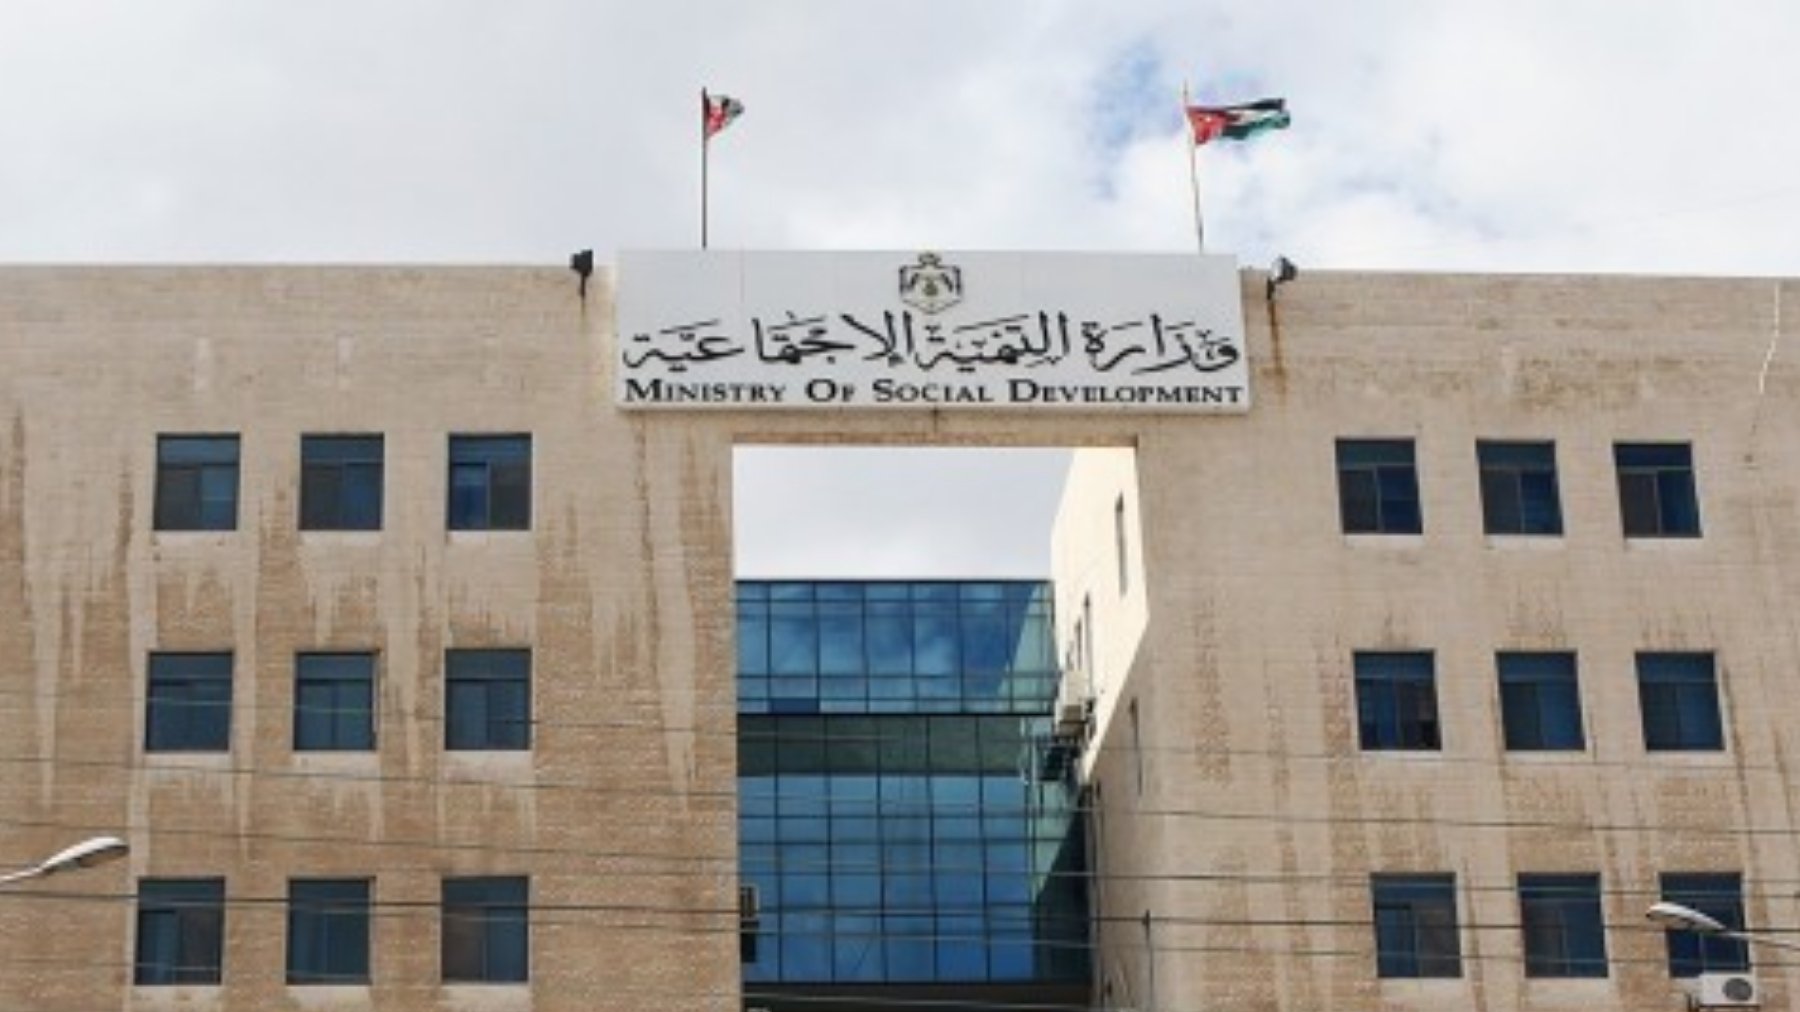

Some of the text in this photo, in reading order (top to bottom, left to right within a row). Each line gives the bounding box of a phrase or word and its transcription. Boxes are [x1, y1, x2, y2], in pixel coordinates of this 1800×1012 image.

[915, 310, 1070, 373] التنمية
[1082, 312, 1238, 375] وزارة
[624, 378, 1243, 403] MINISTRY OF SOCIAL DEVELOPMENT
